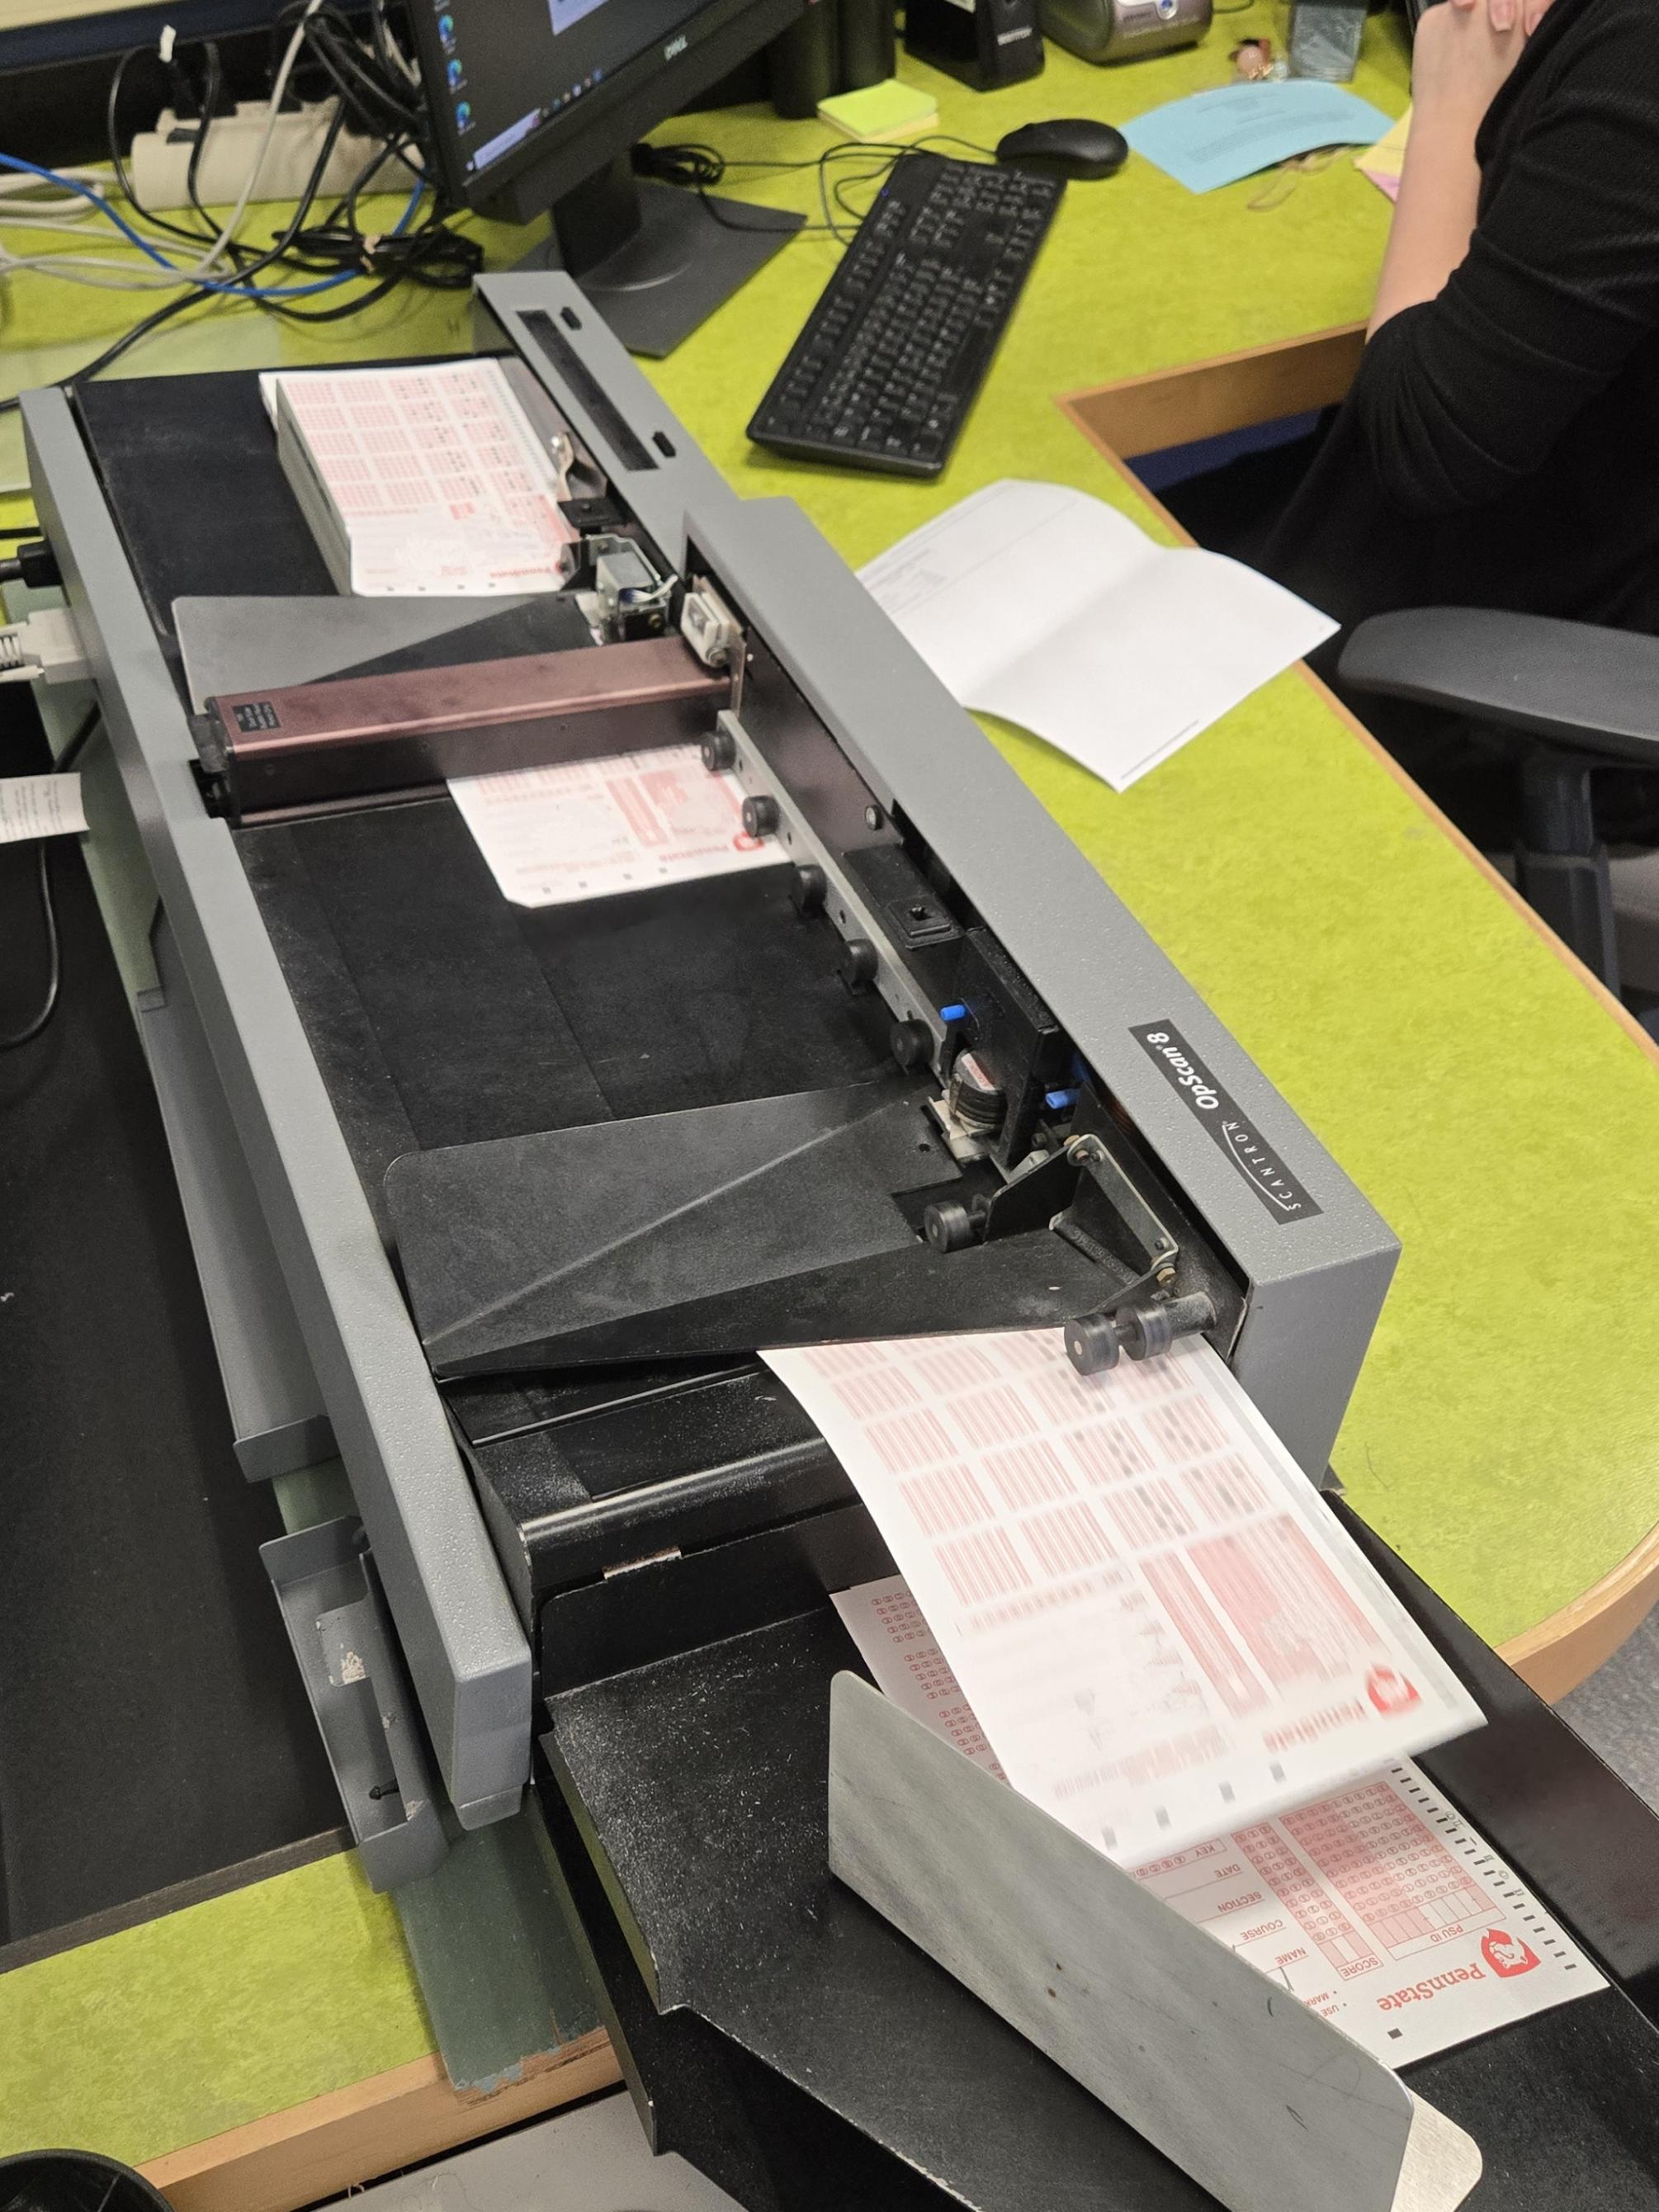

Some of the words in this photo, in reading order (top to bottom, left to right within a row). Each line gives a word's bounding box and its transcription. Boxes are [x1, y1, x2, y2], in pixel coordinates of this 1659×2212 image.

[1146, 1032, 1170, 1043] 8
[1162, 1047, 1219, 1109] OpScan
[1226, 1121, 1301, 1211] SCANTRON
[1195, 1844, 1216, 1857] KEY
[1214, 1864, 1241, 1879] DATE
[1217, 1891, 1262, 1912] SECTION
[1240, 1919, 1283, 1940] COURSE
[1430, 1933, 1443, 1943] ID
[1442, 1924, 1464, 1939] PSU
[1274, 1946, 1307, 1965] NAME
[1340, 1956, 1379, 1978] SCORE
[1376, 1962, 1486, 2011] PennState
[1321, 2004, 1340, 2017] USE
